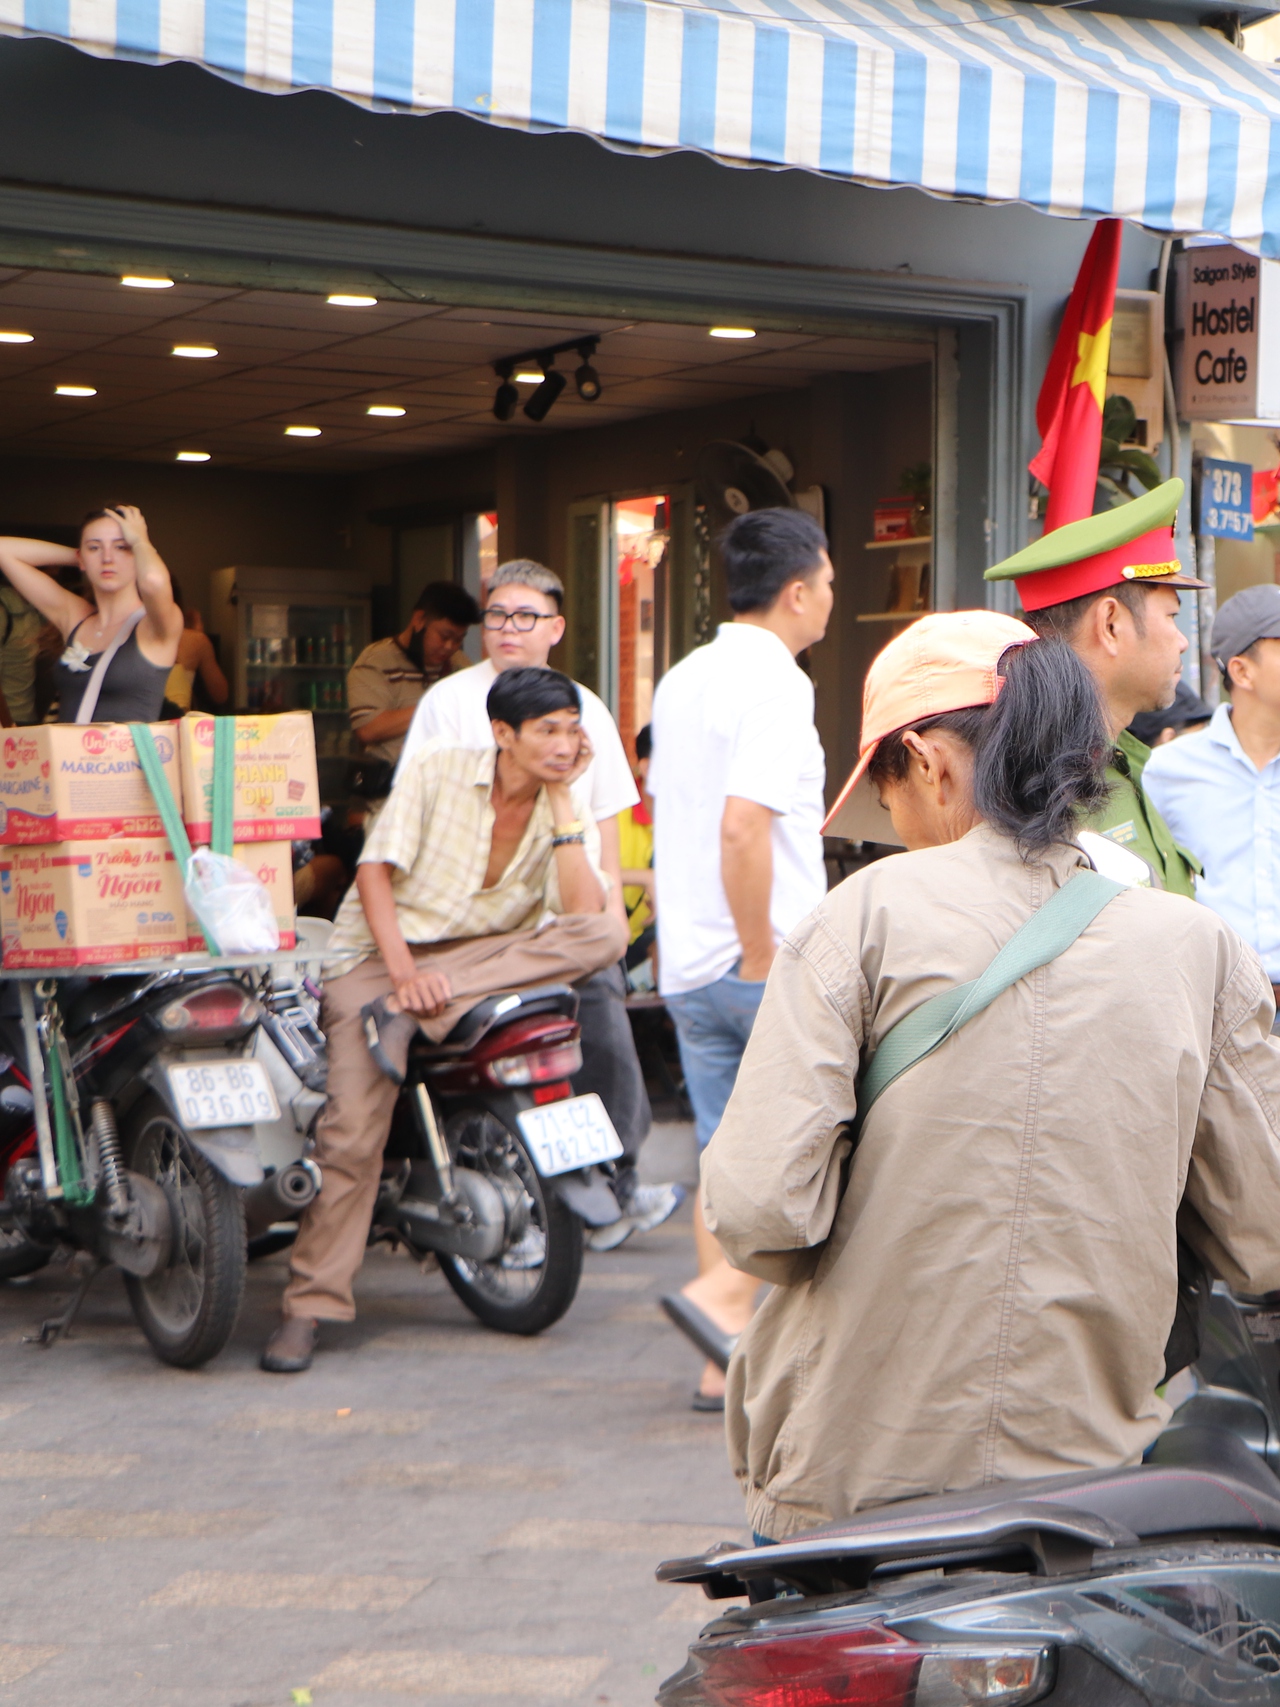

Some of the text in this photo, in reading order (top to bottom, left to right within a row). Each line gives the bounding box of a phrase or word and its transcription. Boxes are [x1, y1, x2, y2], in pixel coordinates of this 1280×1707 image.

[1193, 262, 1257, 286] Saigon Style
[1192, 297, 1255, 336] Hostel
[1195, 348, 1248, 385] Cafe
[1212, 468, 1243, 507] 373
[61, 759, 144, 775] MARGARIN
[235, 764, 287, 784] HANH
[186, 1064, 254, 1093] 86-B6
[185, 1091, 273, 1123] 036.09
